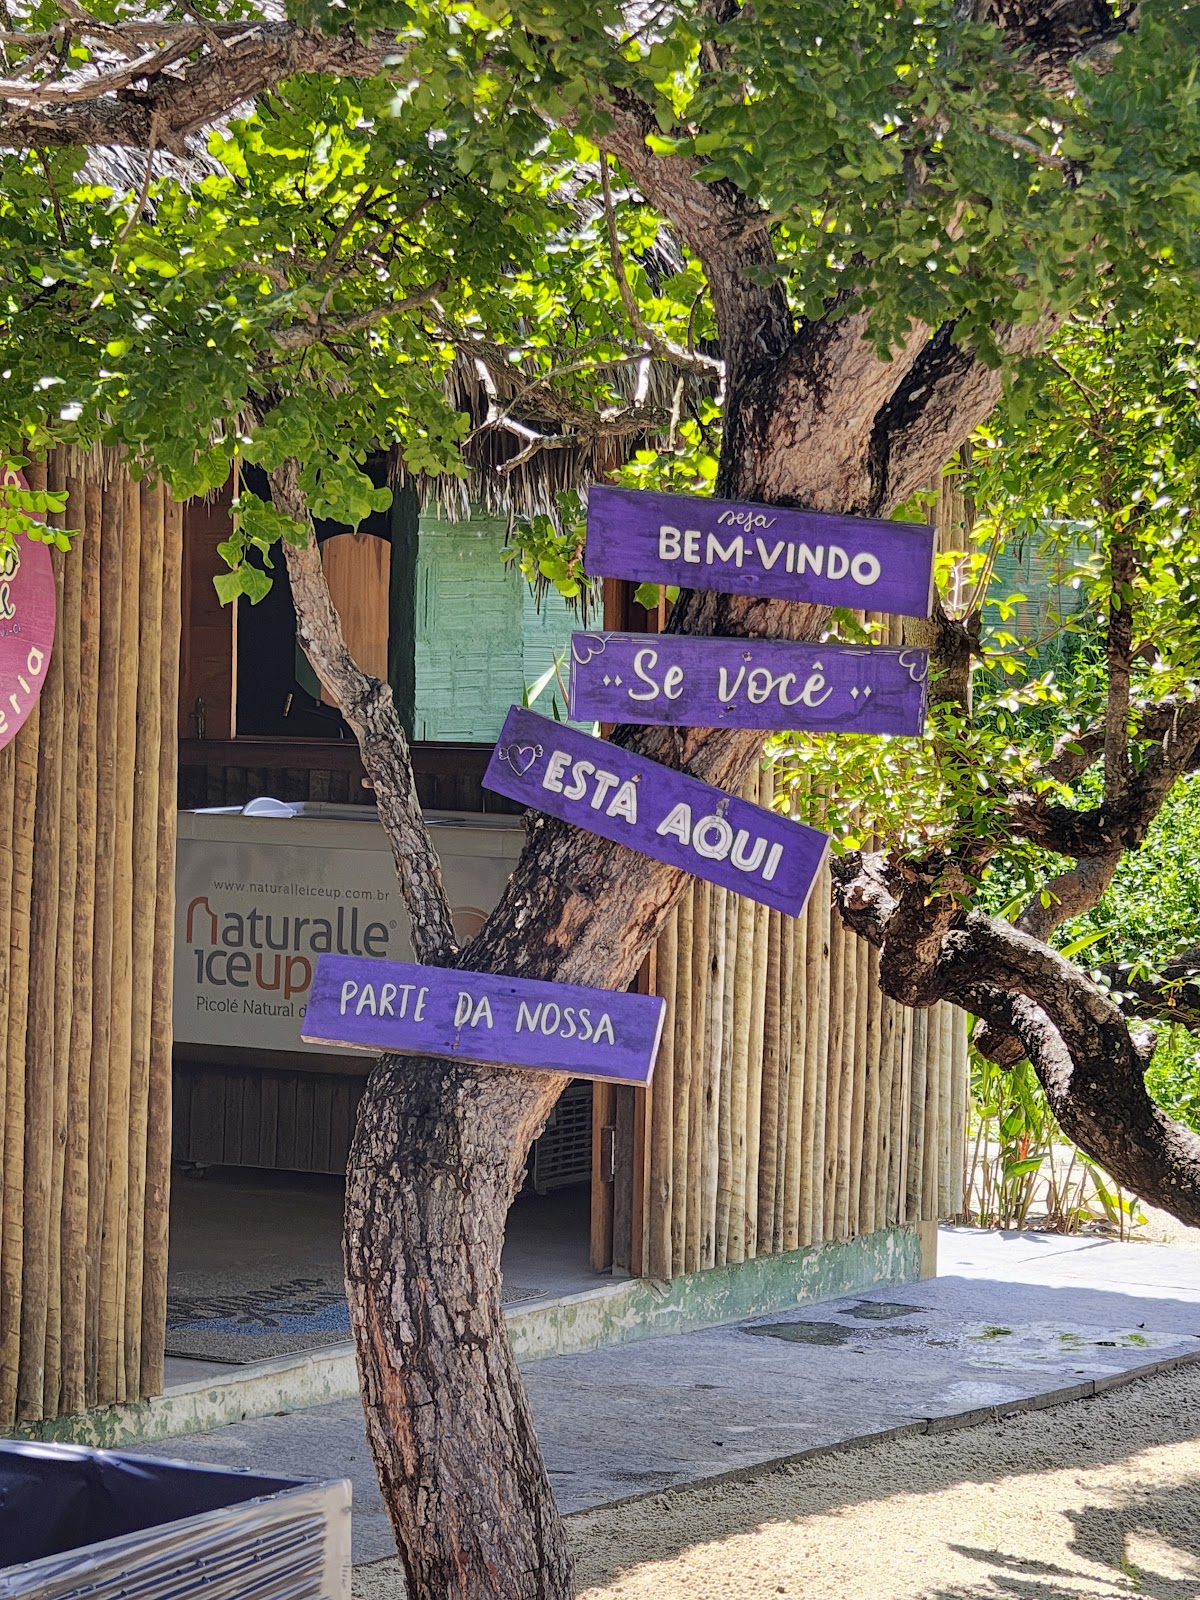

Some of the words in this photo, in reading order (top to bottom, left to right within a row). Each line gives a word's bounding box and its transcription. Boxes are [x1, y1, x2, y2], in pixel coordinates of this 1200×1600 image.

[717, 510, 777, 532] seja
[658, 525, 882, 586] BEM-VINDO
[628, 649, 685, 702] Se
[717, 661, 833, 708] você
[542, 750, 643, 825] ESTÁ
[656, 802, 784, 881] AQUI
[213, 880, 390, 900] www.naturalleiceup.com.br
[196, 996, 239, 1013] Picolé
[243, 999, 294, 1018] Natural
[340, 980, 430, 1023] PARTE
[453, 991, 494, 1030] DA
[515, 1001, 615, 1046] NOSSA
